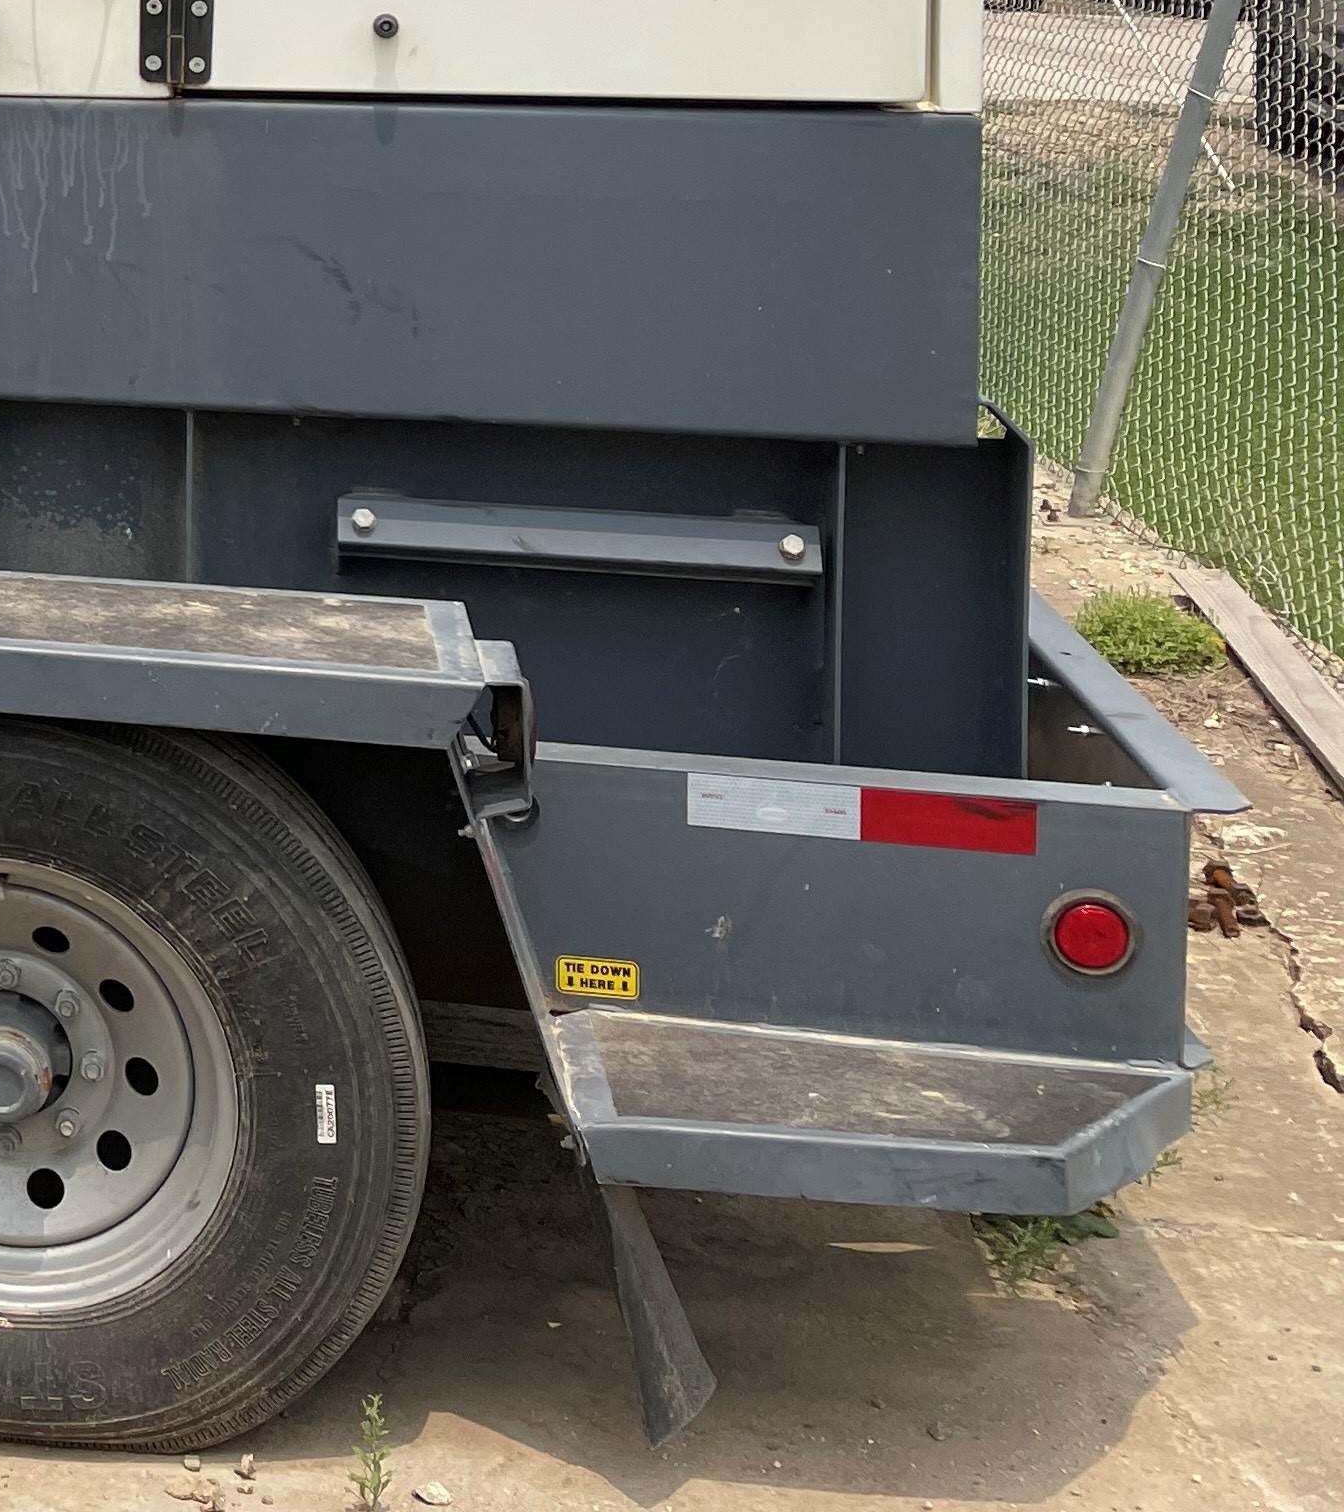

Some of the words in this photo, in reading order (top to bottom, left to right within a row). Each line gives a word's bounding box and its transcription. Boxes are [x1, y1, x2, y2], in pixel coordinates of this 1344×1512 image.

[124, 822, 269, 966] STEEL
[564, 962, 584, 974] TIE
[591, 965, 631, 977] DOWN
[580, 978, 615, 990] HERE
[289, 1175, 338, 1268] TUBELESS
[265, 1265, 303, 1302] ALL
[224, 1298, 280, 1349] STEEL
[161, 1339, 233, 1390] RADIAL
